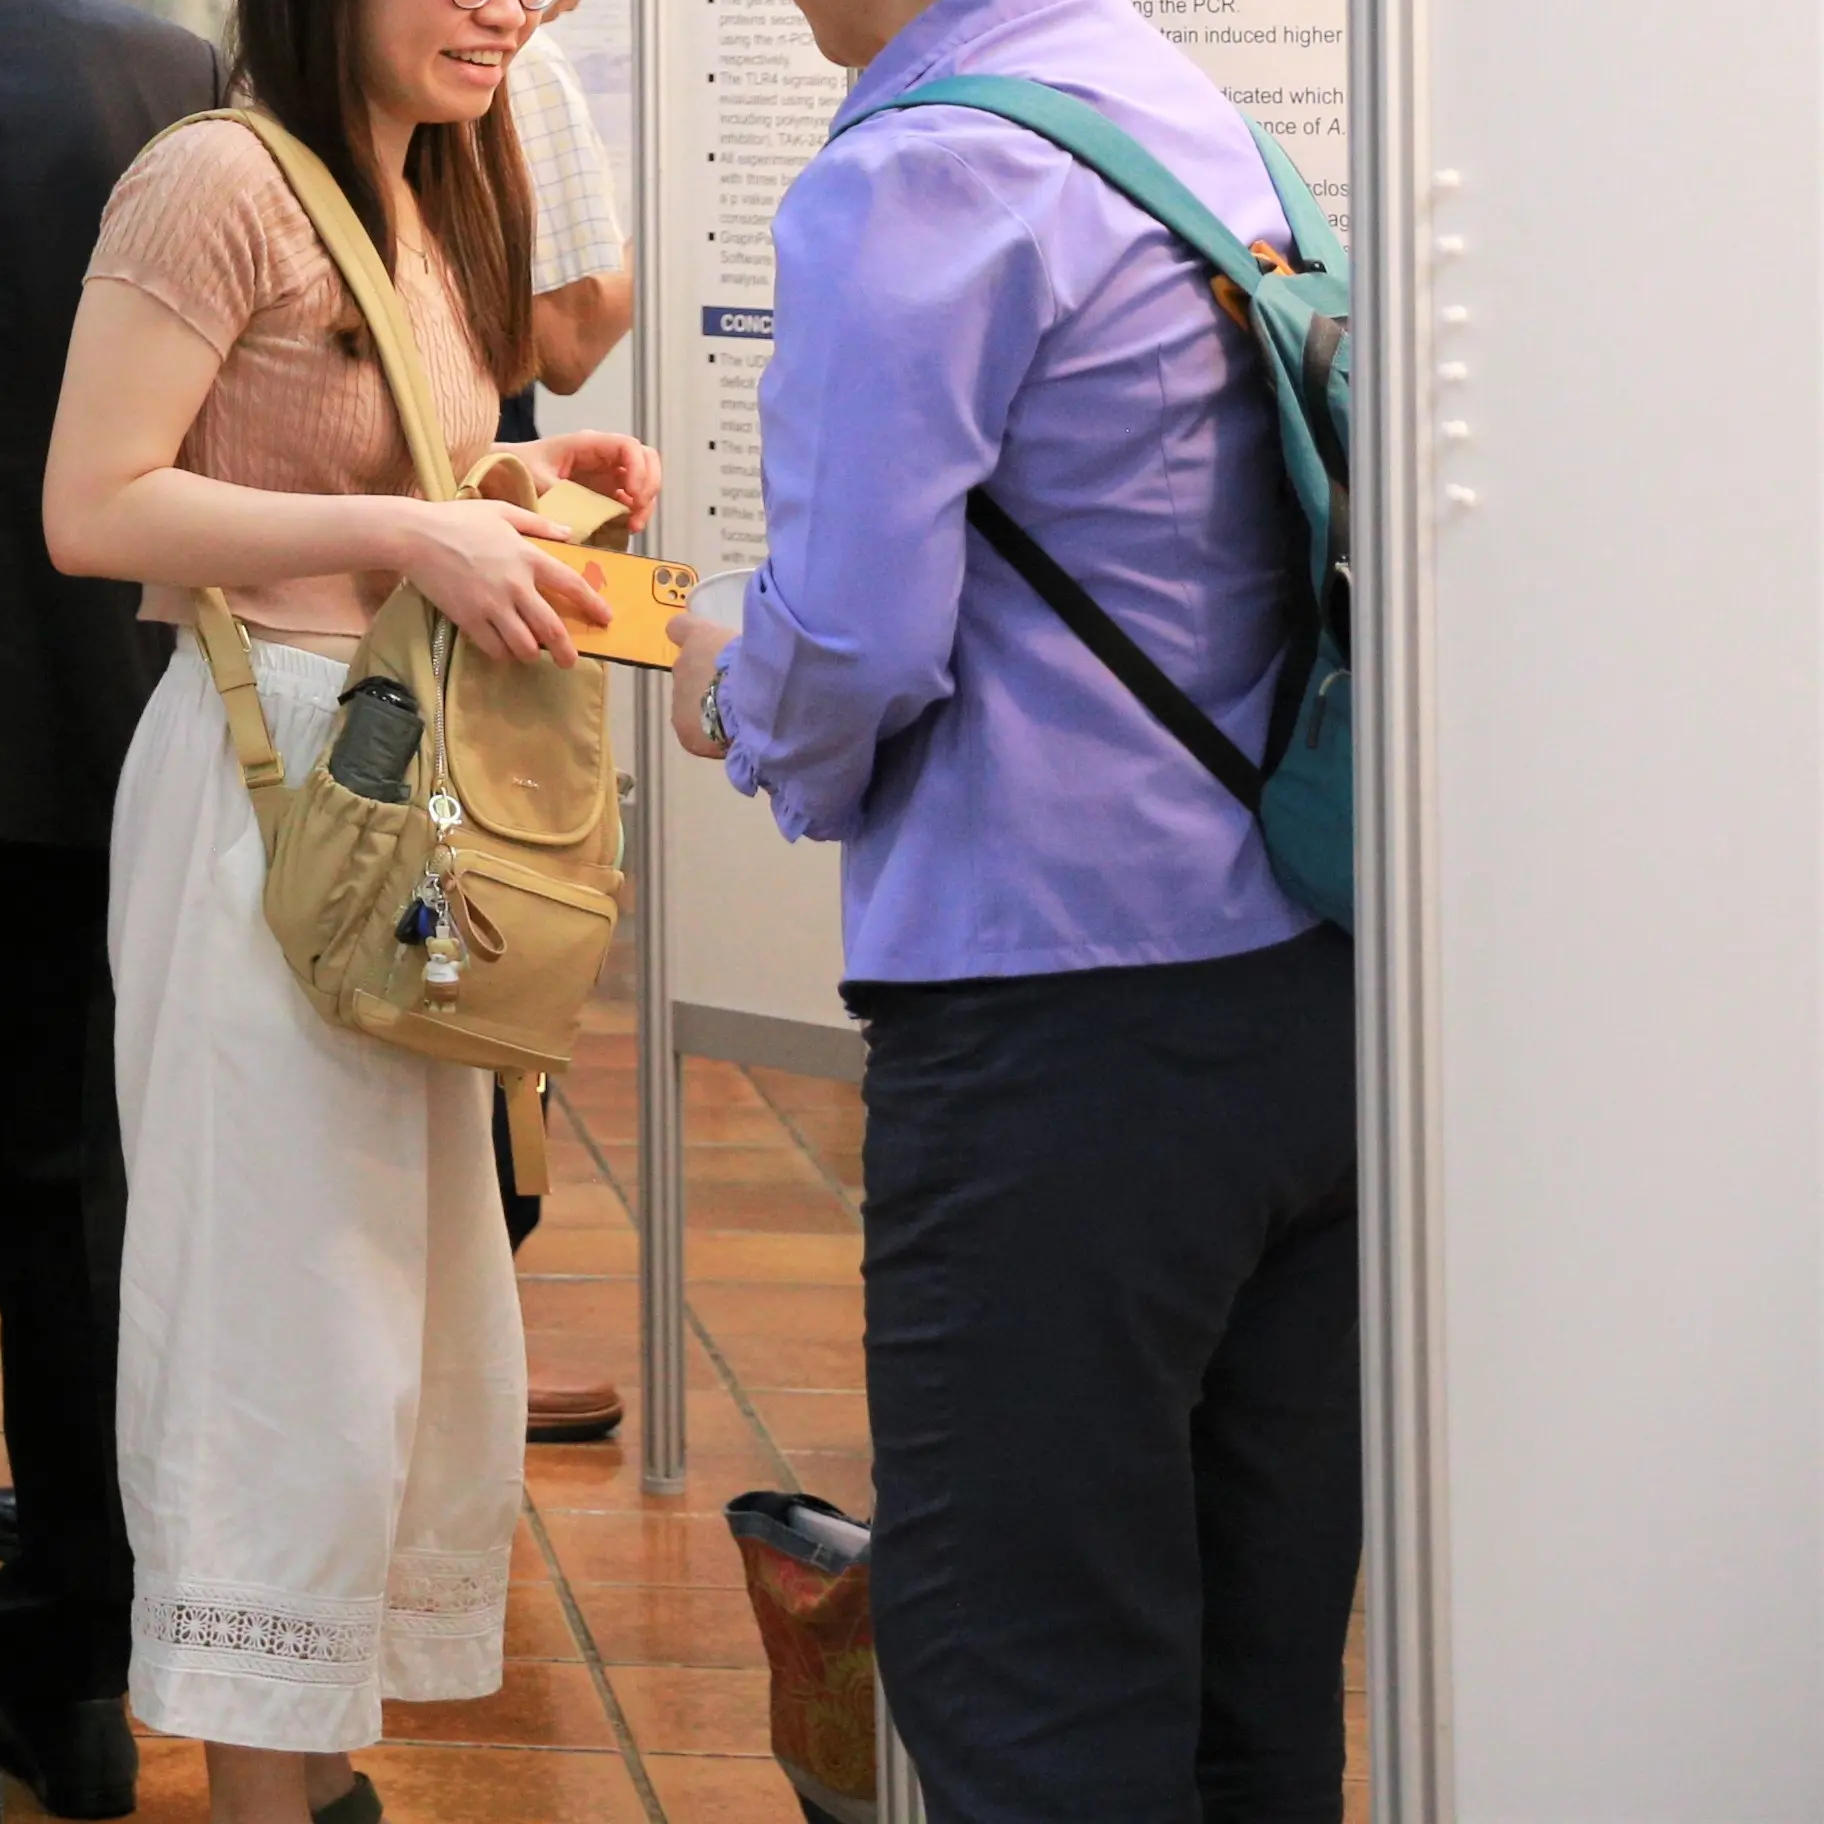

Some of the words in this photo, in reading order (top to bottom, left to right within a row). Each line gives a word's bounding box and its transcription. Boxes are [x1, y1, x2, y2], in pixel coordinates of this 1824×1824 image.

[1205, 25, 1277, 44] induced
[1283, 25, 1343, 48] higher
[1290, 86, 1344, 105] which
[1303, 117, 1321, 135] of
[720, 312, 774, 334] CONC
